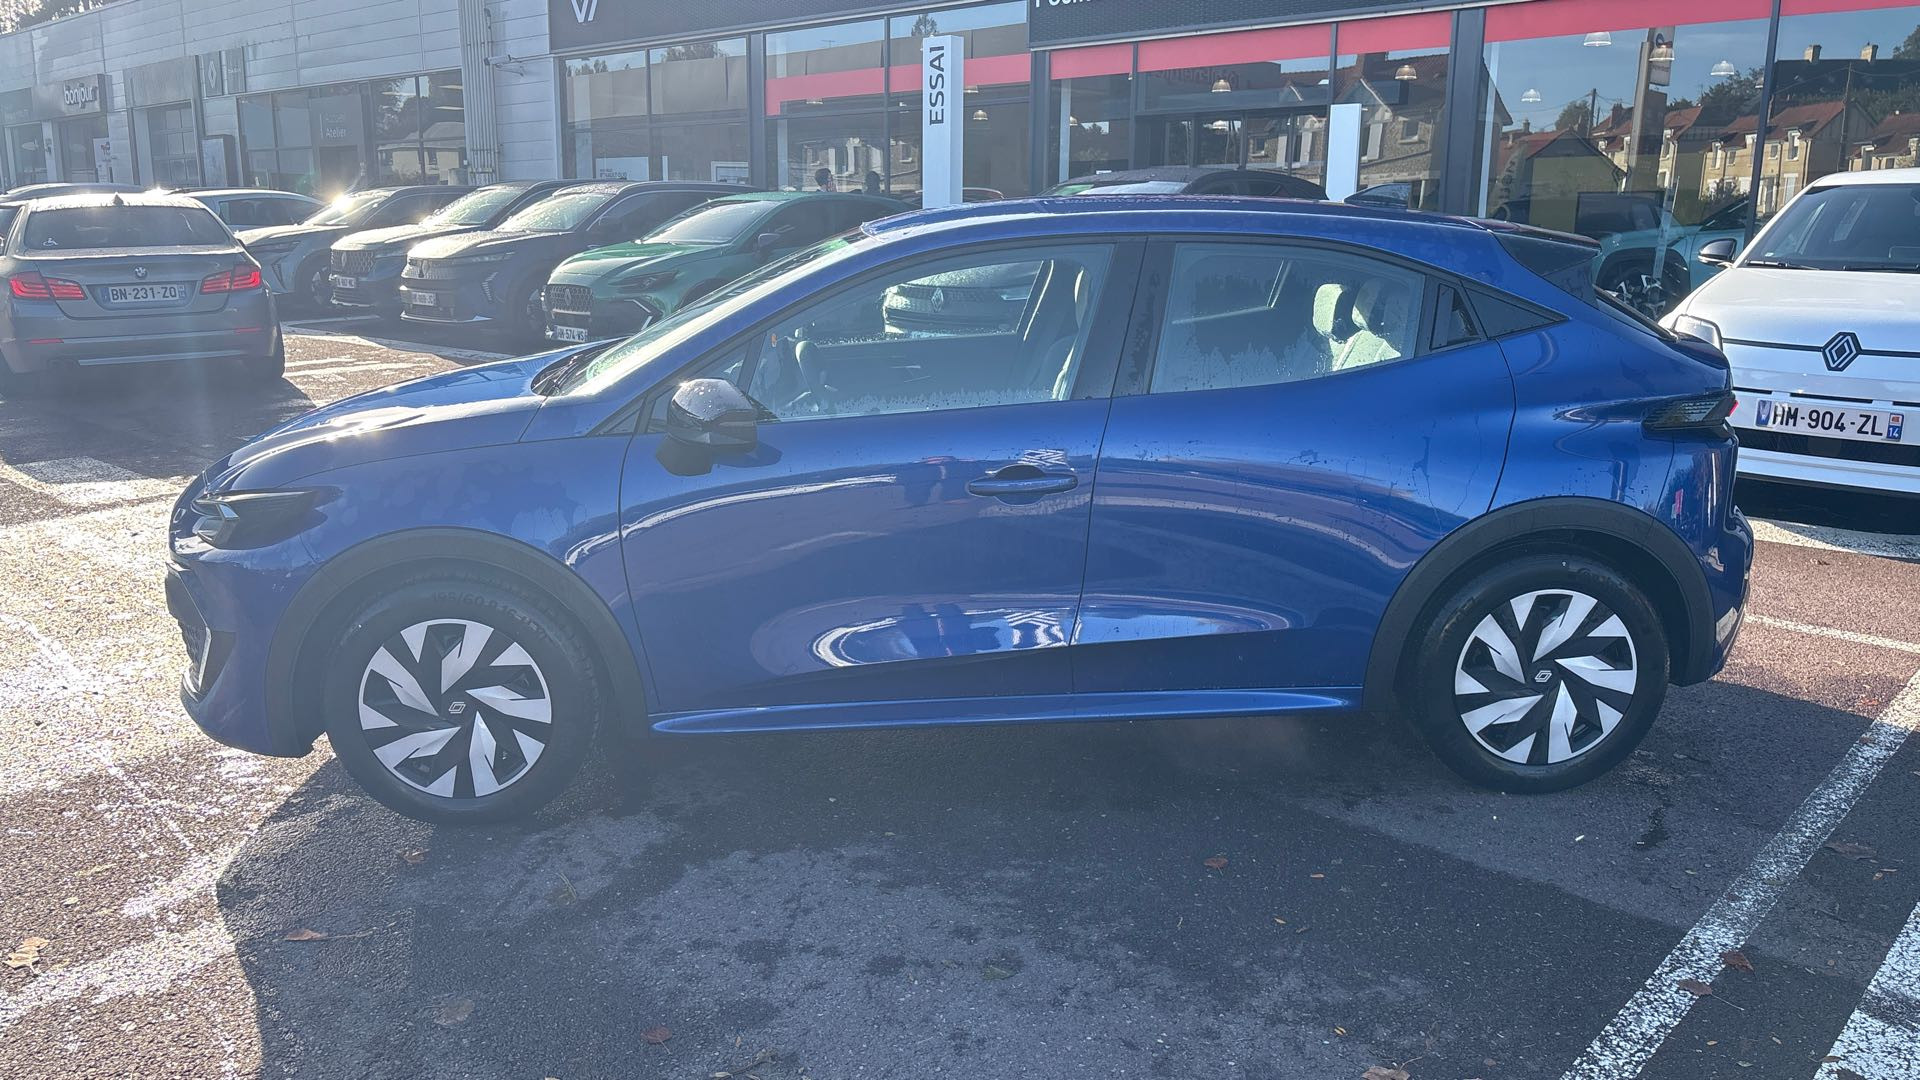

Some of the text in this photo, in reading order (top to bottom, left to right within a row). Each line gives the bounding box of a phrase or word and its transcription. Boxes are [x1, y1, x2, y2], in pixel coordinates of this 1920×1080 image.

[929, 46, 945, 126] ESSAI
[1772, 404, 1883, 437] HM-904-ZL
[1888, 427, 1899, 438] 14
